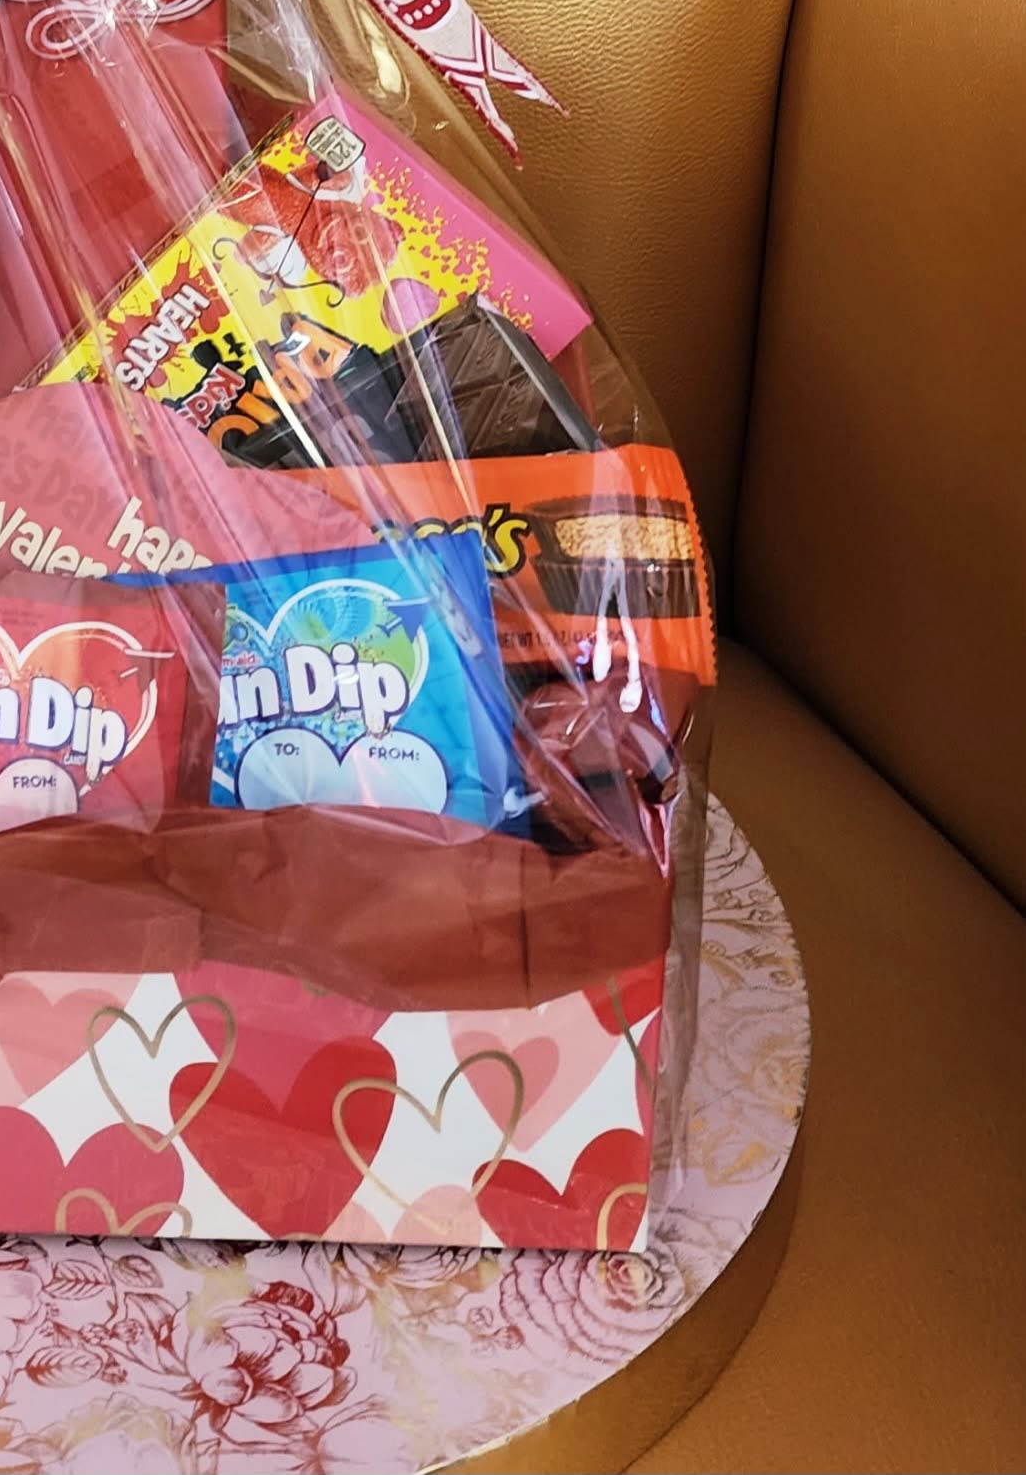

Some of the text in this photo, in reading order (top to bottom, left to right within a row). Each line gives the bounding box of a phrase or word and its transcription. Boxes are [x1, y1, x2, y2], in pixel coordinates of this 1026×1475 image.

[115, 283, 211, 391] HEARTS
[28, 676, 127, 782] Dip
[285, 643, 409, 735] Dip
[13, 775, 57, 790] FROM:
[274, 743, 420, 761] TO: FROM:
